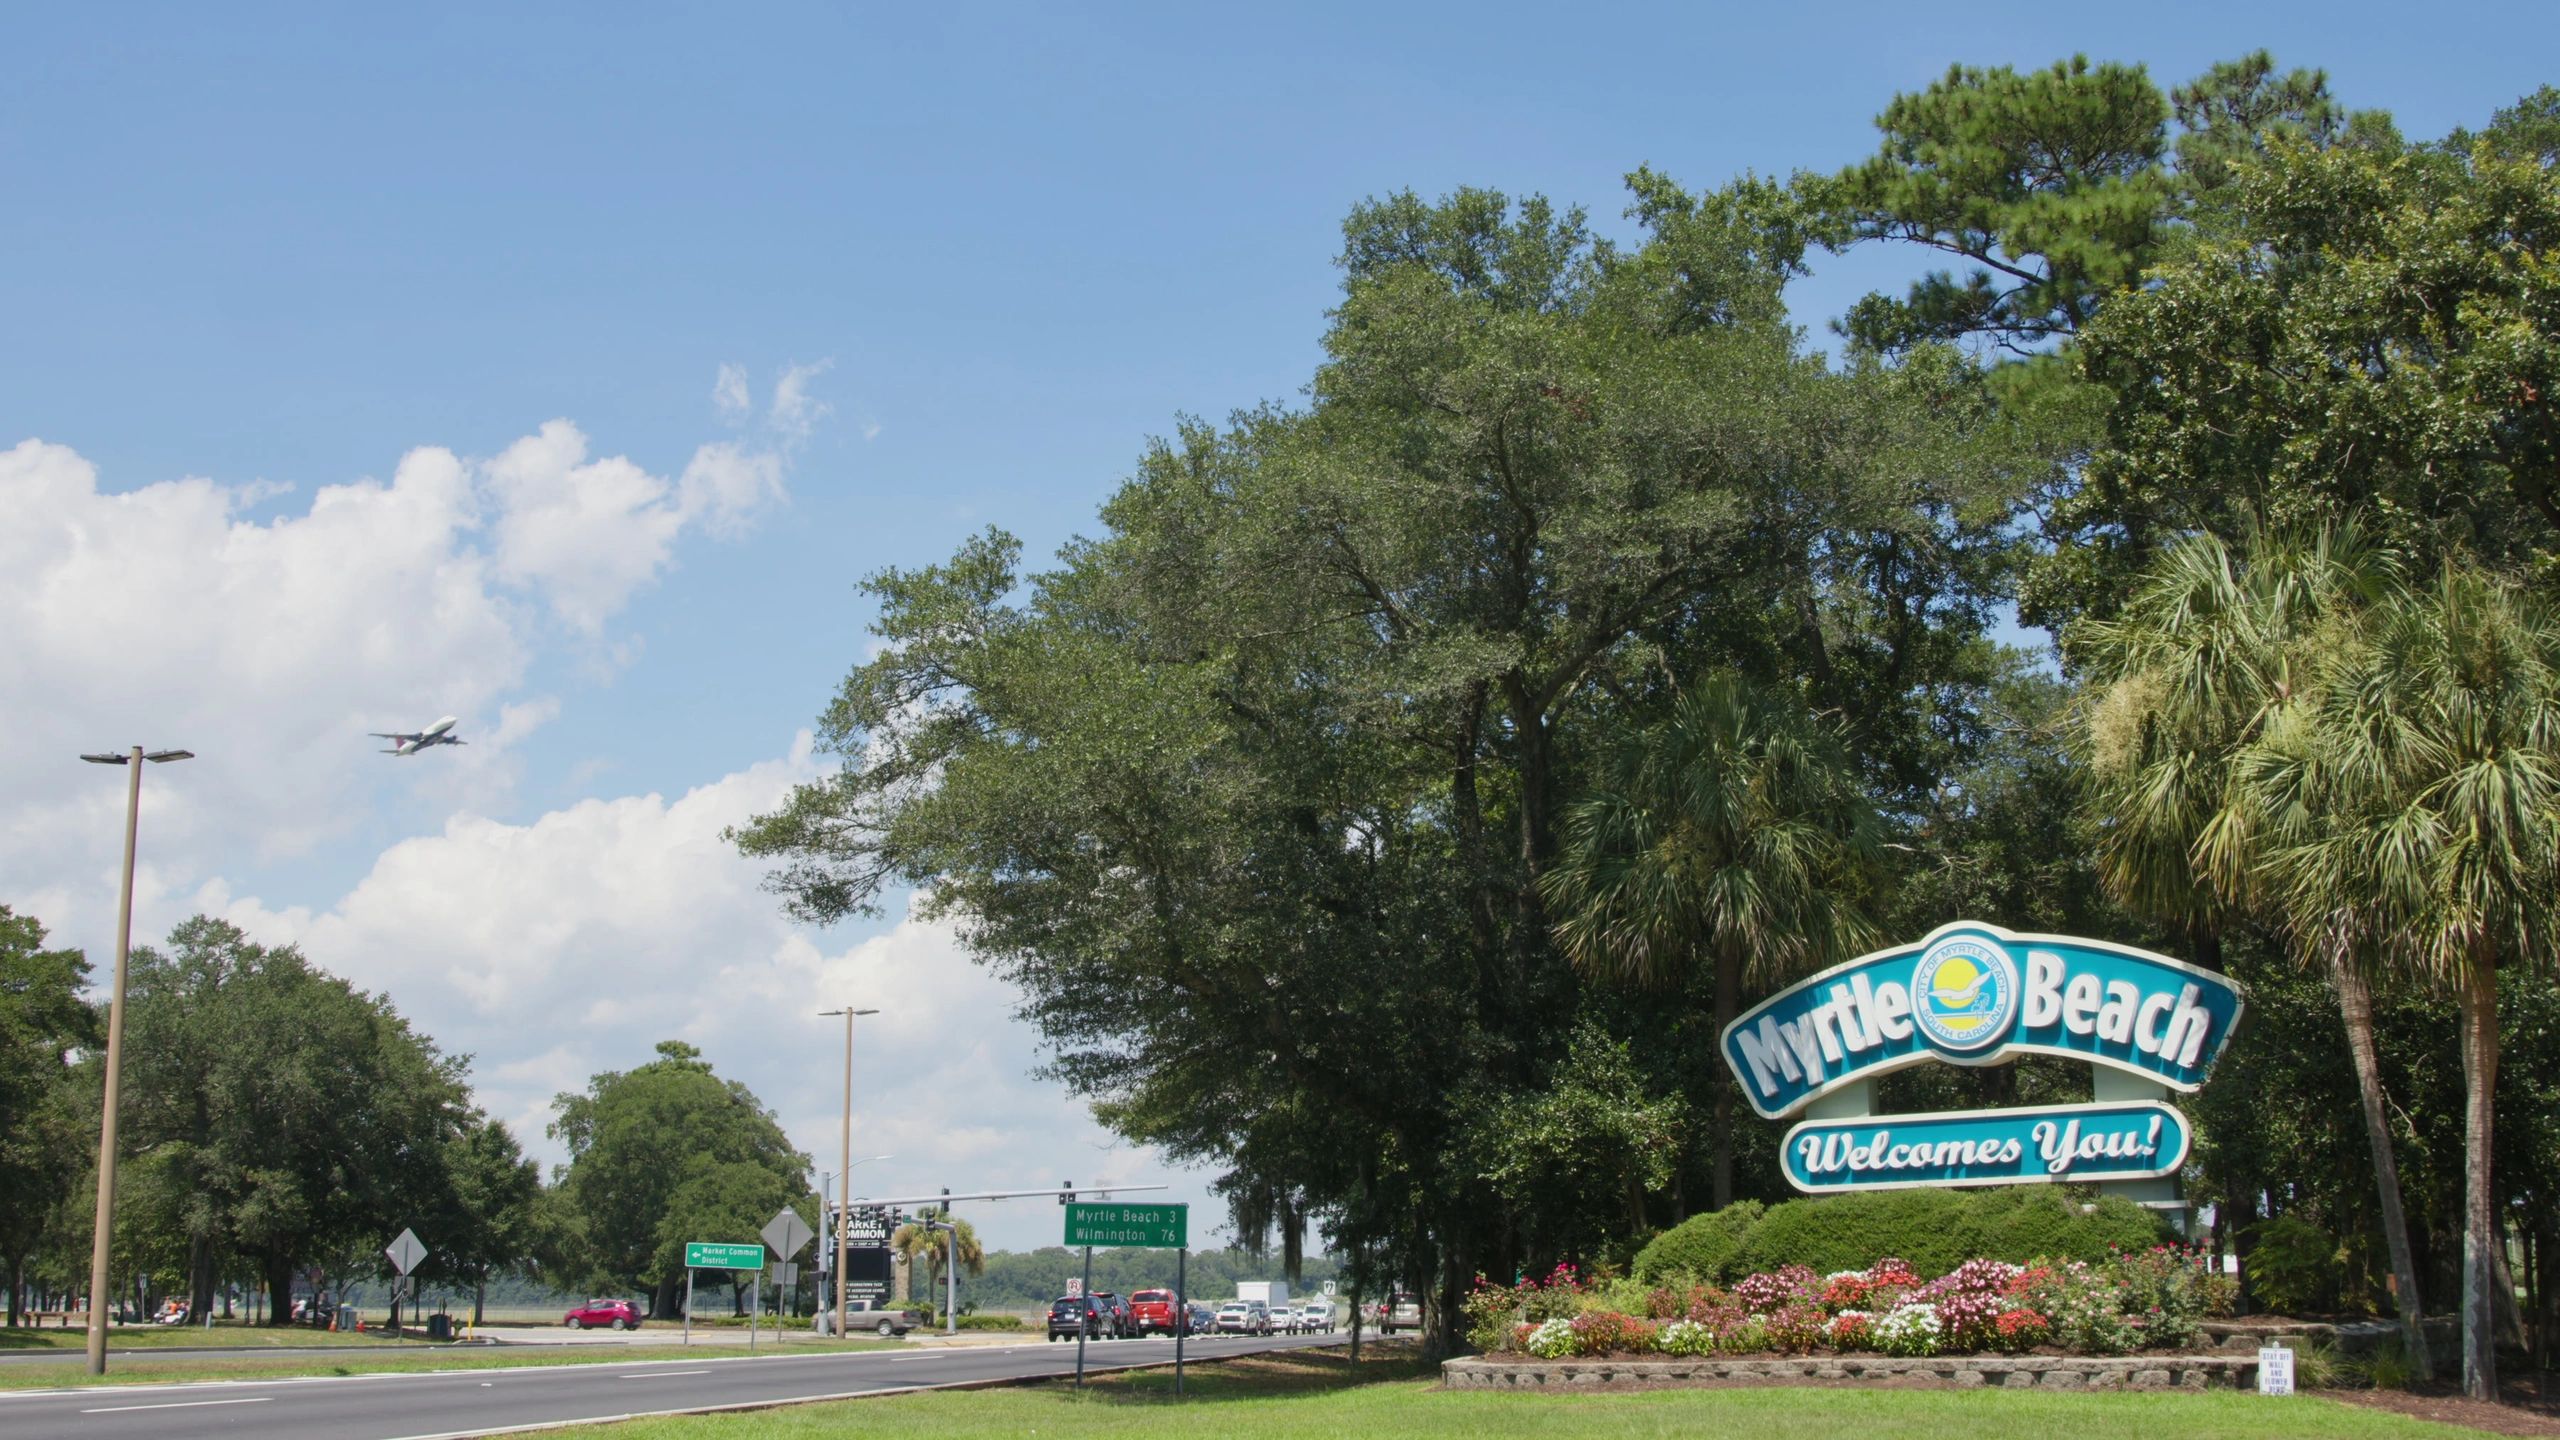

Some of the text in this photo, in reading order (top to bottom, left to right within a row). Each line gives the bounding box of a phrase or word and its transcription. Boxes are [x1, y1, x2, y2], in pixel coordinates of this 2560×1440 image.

[1919, 945, 2006, 998] CITY OF MYRTLE BEACH
[1736, 950, 2212, 1098] Myrtle Beach
[1922, 1003, 2004, 1040] SOUTH CAROLINA
[1798, 1114, 2162, 1173] Welcomes You!
[1076, 1209, 1176, 1223] Myrtle Beach 3
[1076, 1228, 1176, 1243] Wilmington 76
[702, 1247, 758, 1257] Market Common
[701, 1256, 728, 1265] District
[2270, 1369, 2282, 1377] AND
